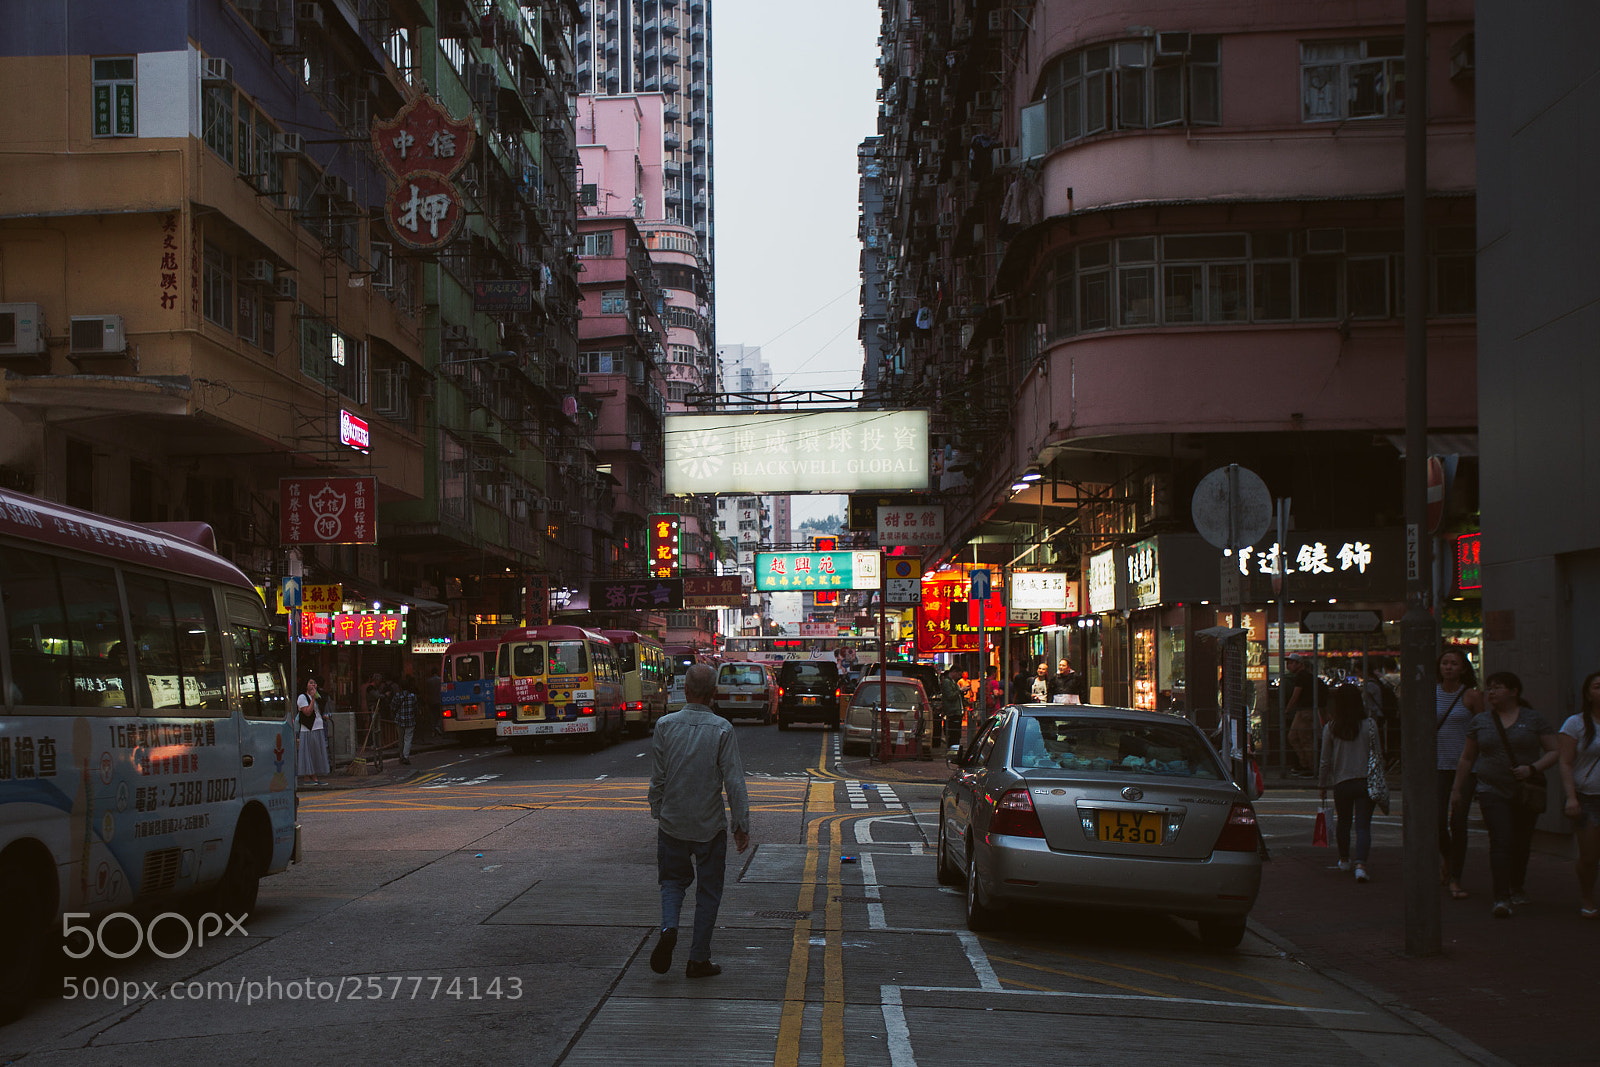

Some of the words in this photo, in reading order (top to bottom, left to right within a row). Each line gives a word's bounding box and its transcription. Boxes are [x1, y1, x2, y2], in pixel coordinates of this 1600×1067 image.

[392, 129, 457, 159] 中信
[397, 184, 452, 239] 押
[733, 426, 918, 455] 博威環球投資
[732, 460, 841, 476] BLACKWELL
[847, 458, 919, 474] GLOBAL
[315, 498, 339, 512] 中信
[5, 503, 43, 529] SEATS
[884, 511, 937, 528] 甜品館
[320, 518, 336, 536] 押
[769, 556, 836, 575] 越興苑
[908, 580, 914, 588] 7
[908, 593, 919, 602] 12
[1029, 612, 1039, 620] 12
[339, 615, 398, 640] 中信押
[931, 633, 960, 649] 21
[168, 781, 203, 808] 2388
[206, 778, 237, 803] 0802
[1116, 811, 1142, 827] LV
[1104, 825, 1157, 844] 1430
